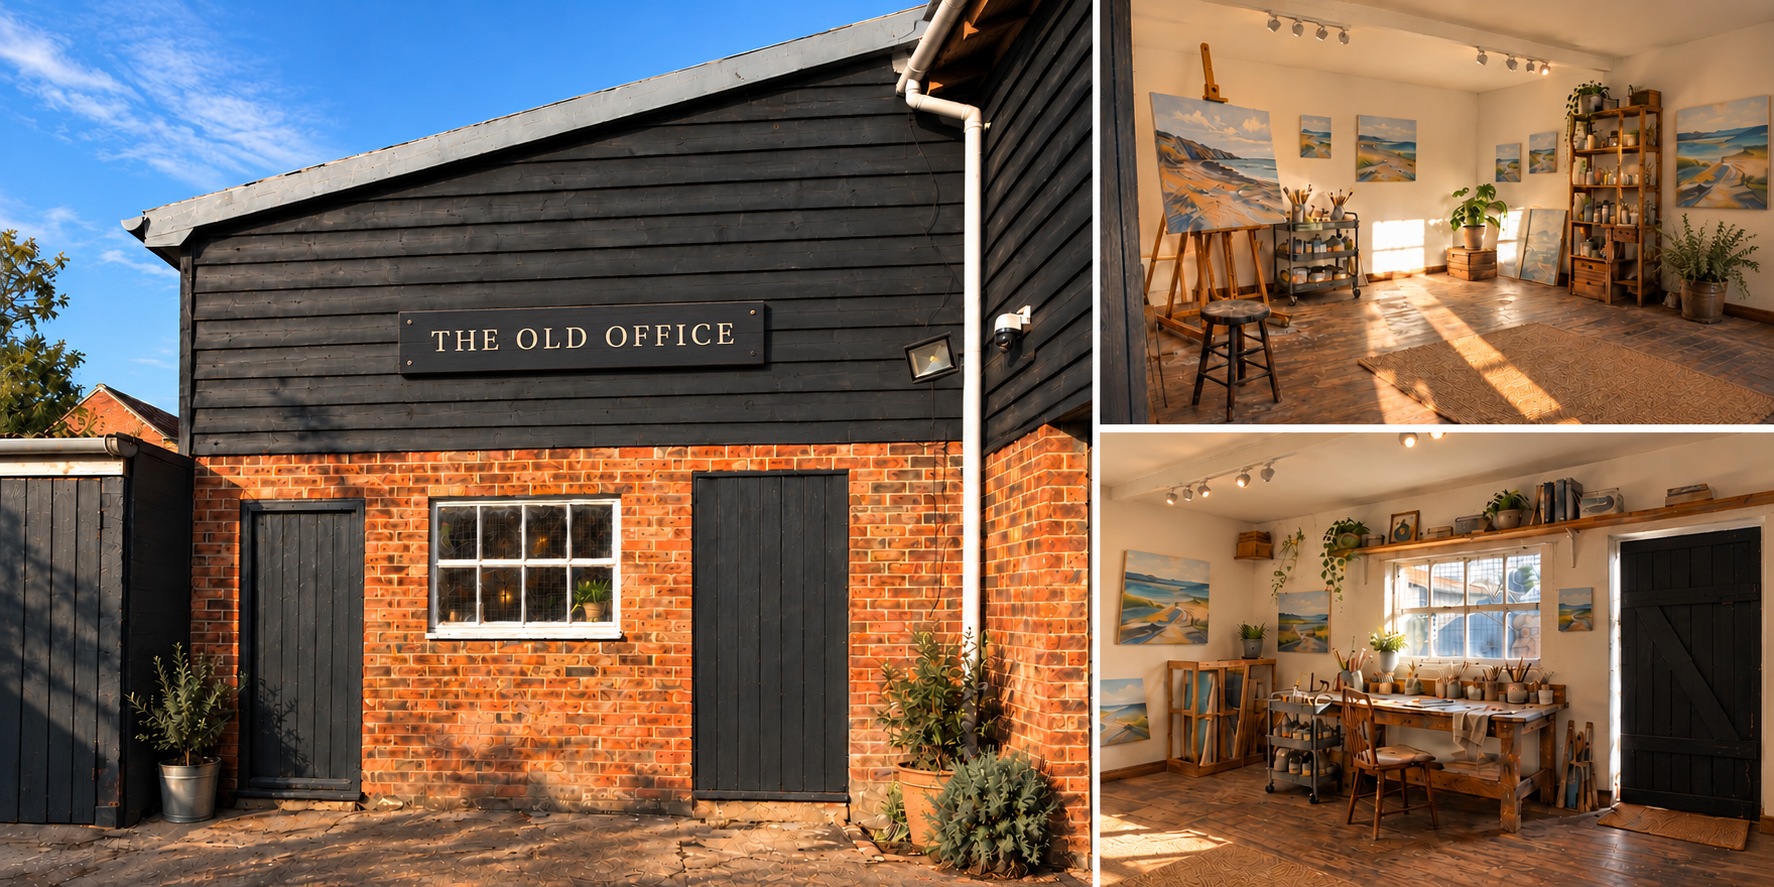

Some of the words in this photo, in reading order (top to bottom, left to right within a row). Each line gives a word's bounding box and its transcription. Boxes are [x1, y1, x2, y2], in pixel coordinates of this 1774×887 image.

[430, 328, 500, 352] THE
[515, 325, 588, 350] OLD
[604, 321, 736, 348] OFFICE
